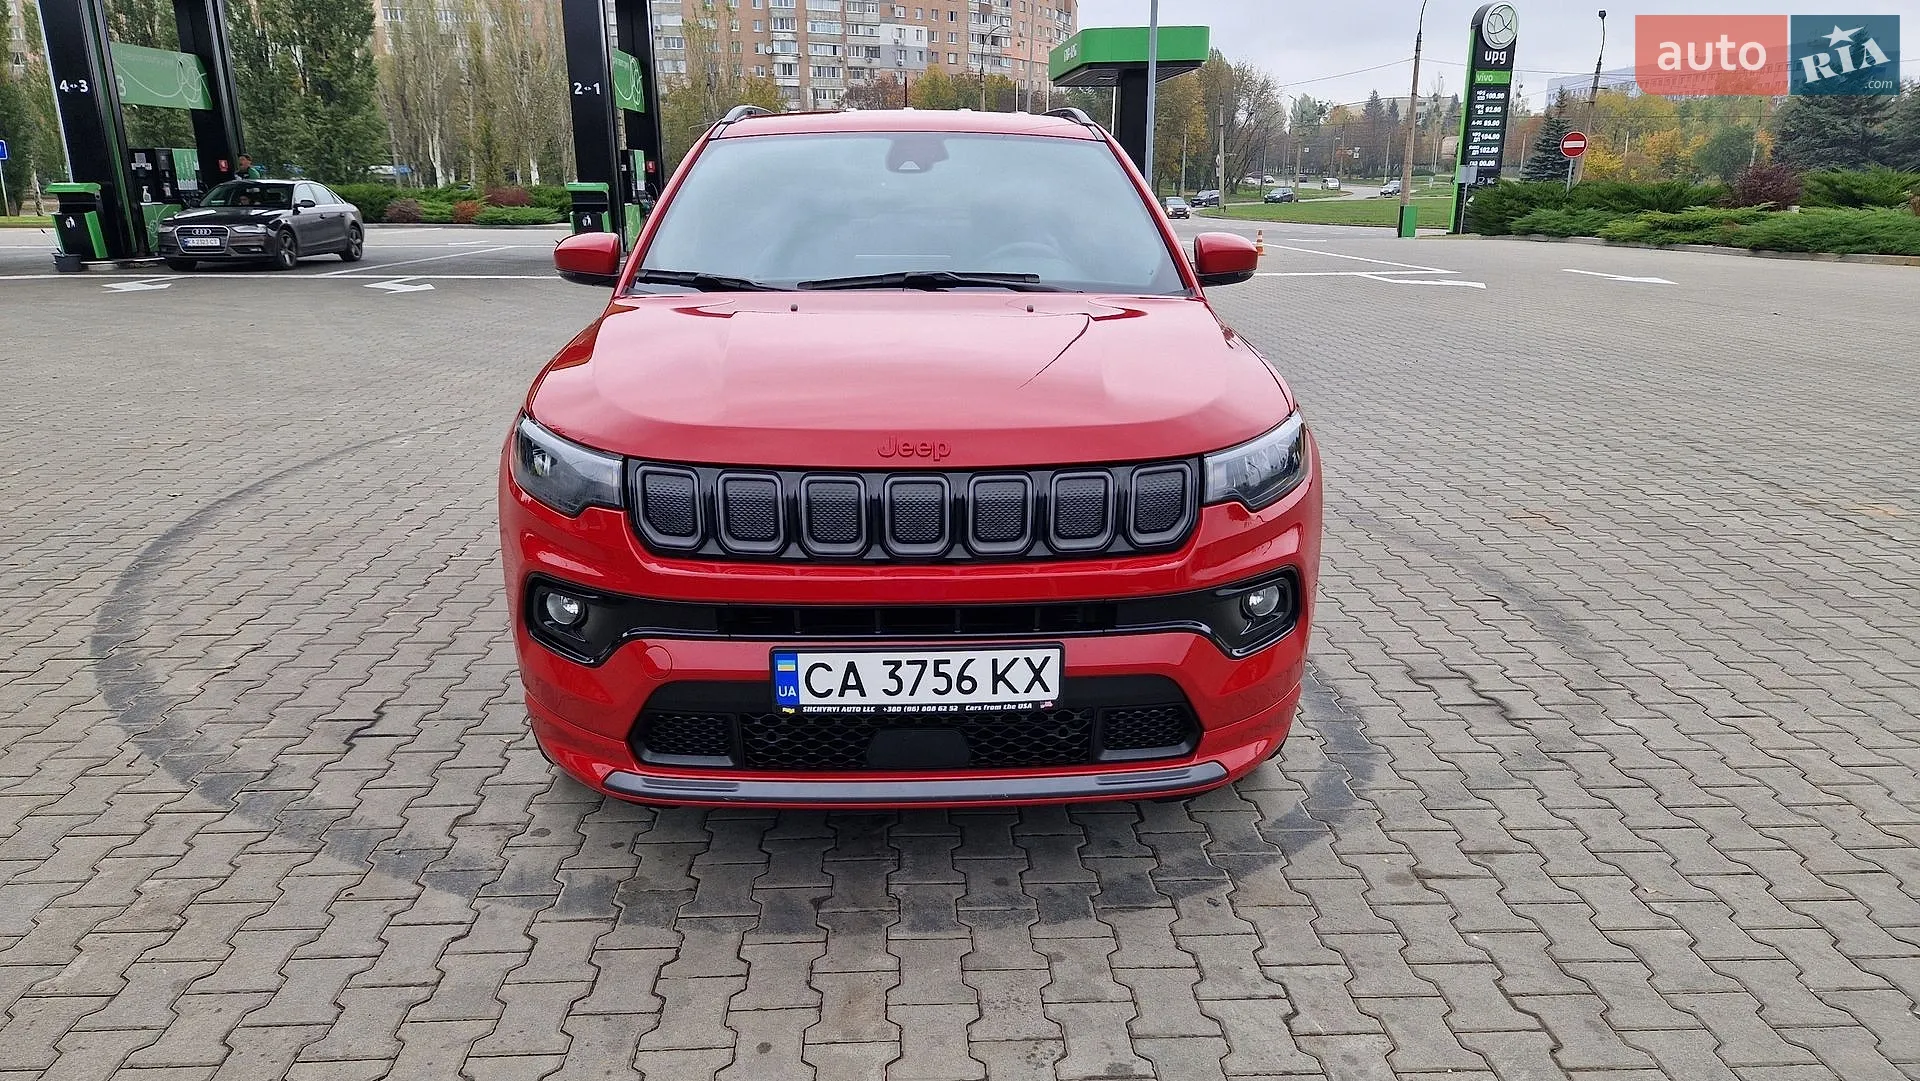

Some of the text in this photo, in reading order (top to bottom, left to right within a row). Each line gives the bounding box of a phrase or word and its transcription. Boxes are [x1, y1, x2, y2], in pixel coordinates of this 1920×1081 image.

[1484, 51, 1507, 65] upg
[60, 80, 88, 93] 4 3
[573, 82, 601, 95] 2 1
[877, 435, 952, 462] Jeep
[804, 655, 1051, 699] CA 3756 KX
[778, 685, 797, 697] UA
